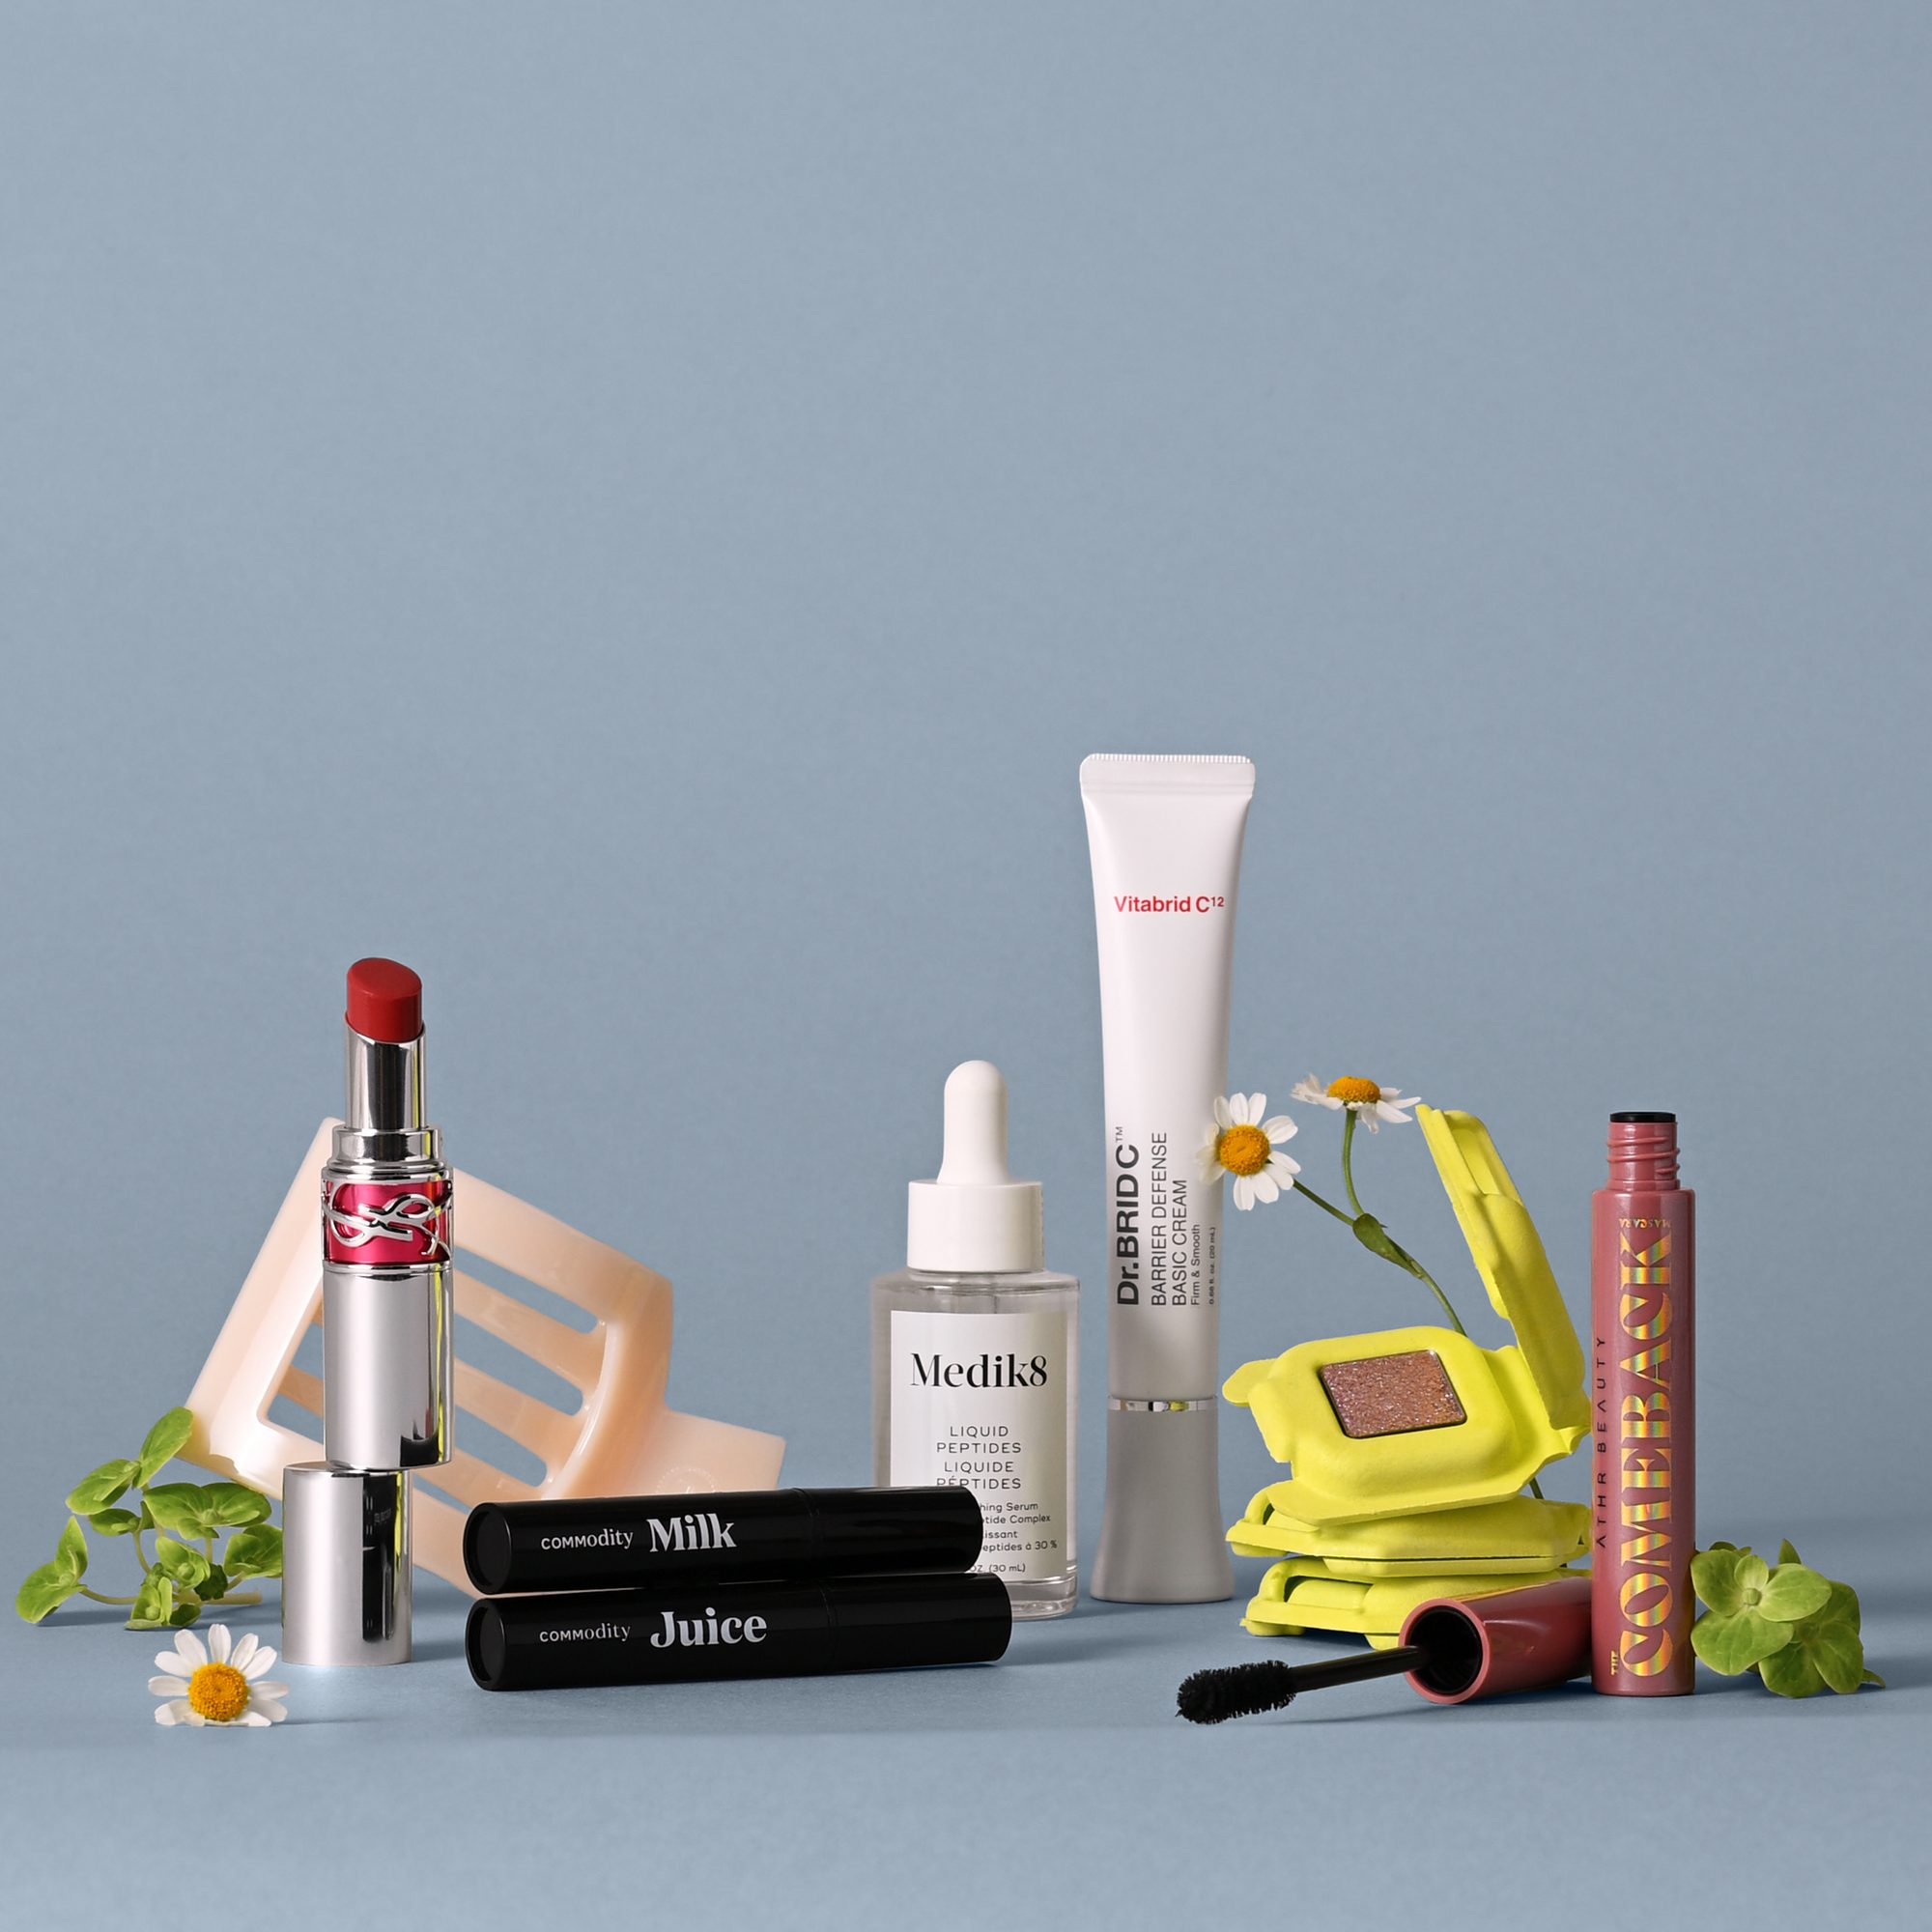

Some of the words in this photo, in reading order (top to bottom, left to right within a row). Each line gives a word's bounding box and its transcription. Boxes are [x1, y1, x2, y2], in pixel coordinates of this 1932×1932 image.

[1114, 895, 1191, 912] Vitabrid
[1151, 1132, 1167, 1218] DEFENSE
[1172, 1179, 1187, 1245] CREAM
[1618, 1218, 1671, 1229] MASCARA
[1190, 1224, 1201, 1266] Smooth
[1151, 1225, 1167, 1305] BARRIER
[1172, 1251, 1187, 1305] BASIC
[1190, 1281, 1201, 1305] Firm
[910, 1352, 1048, 1388] Medik8
[1596, 1336, 1607, 1453] BEAUTY
[950, 1425, 1009, 1438] LIQUID
[936, 1442, 1022, 1455] PEPTIDES
[1618, 1231, 1673, 1677] COMEBACK
[944, 1461, 1014, 1474] LIQUIDE
[936, 1475, 1022, 1490] PÉPTIDES
[980, 1502, 1003, 1513] hing
[1006, 1502, 1038, 1512] Serum
[982, 1515, 1007, 1524] tide
[1009, 1514, 1051, 1525] Complex
[1596, 1472, 1607, 1548] ATHR
[645, 1513, 737, 1552] Milk
[983, 1530, 1018, 1539] issant
[982, 1543, 1022, 1552] eptides
[1035, 1541, 1048, 1550] 30
[988, 1564, 1007, 1573] (30
[1009, 1563, 1026, 1573] mL)
[650, 1606, 768, 1648] Juice
